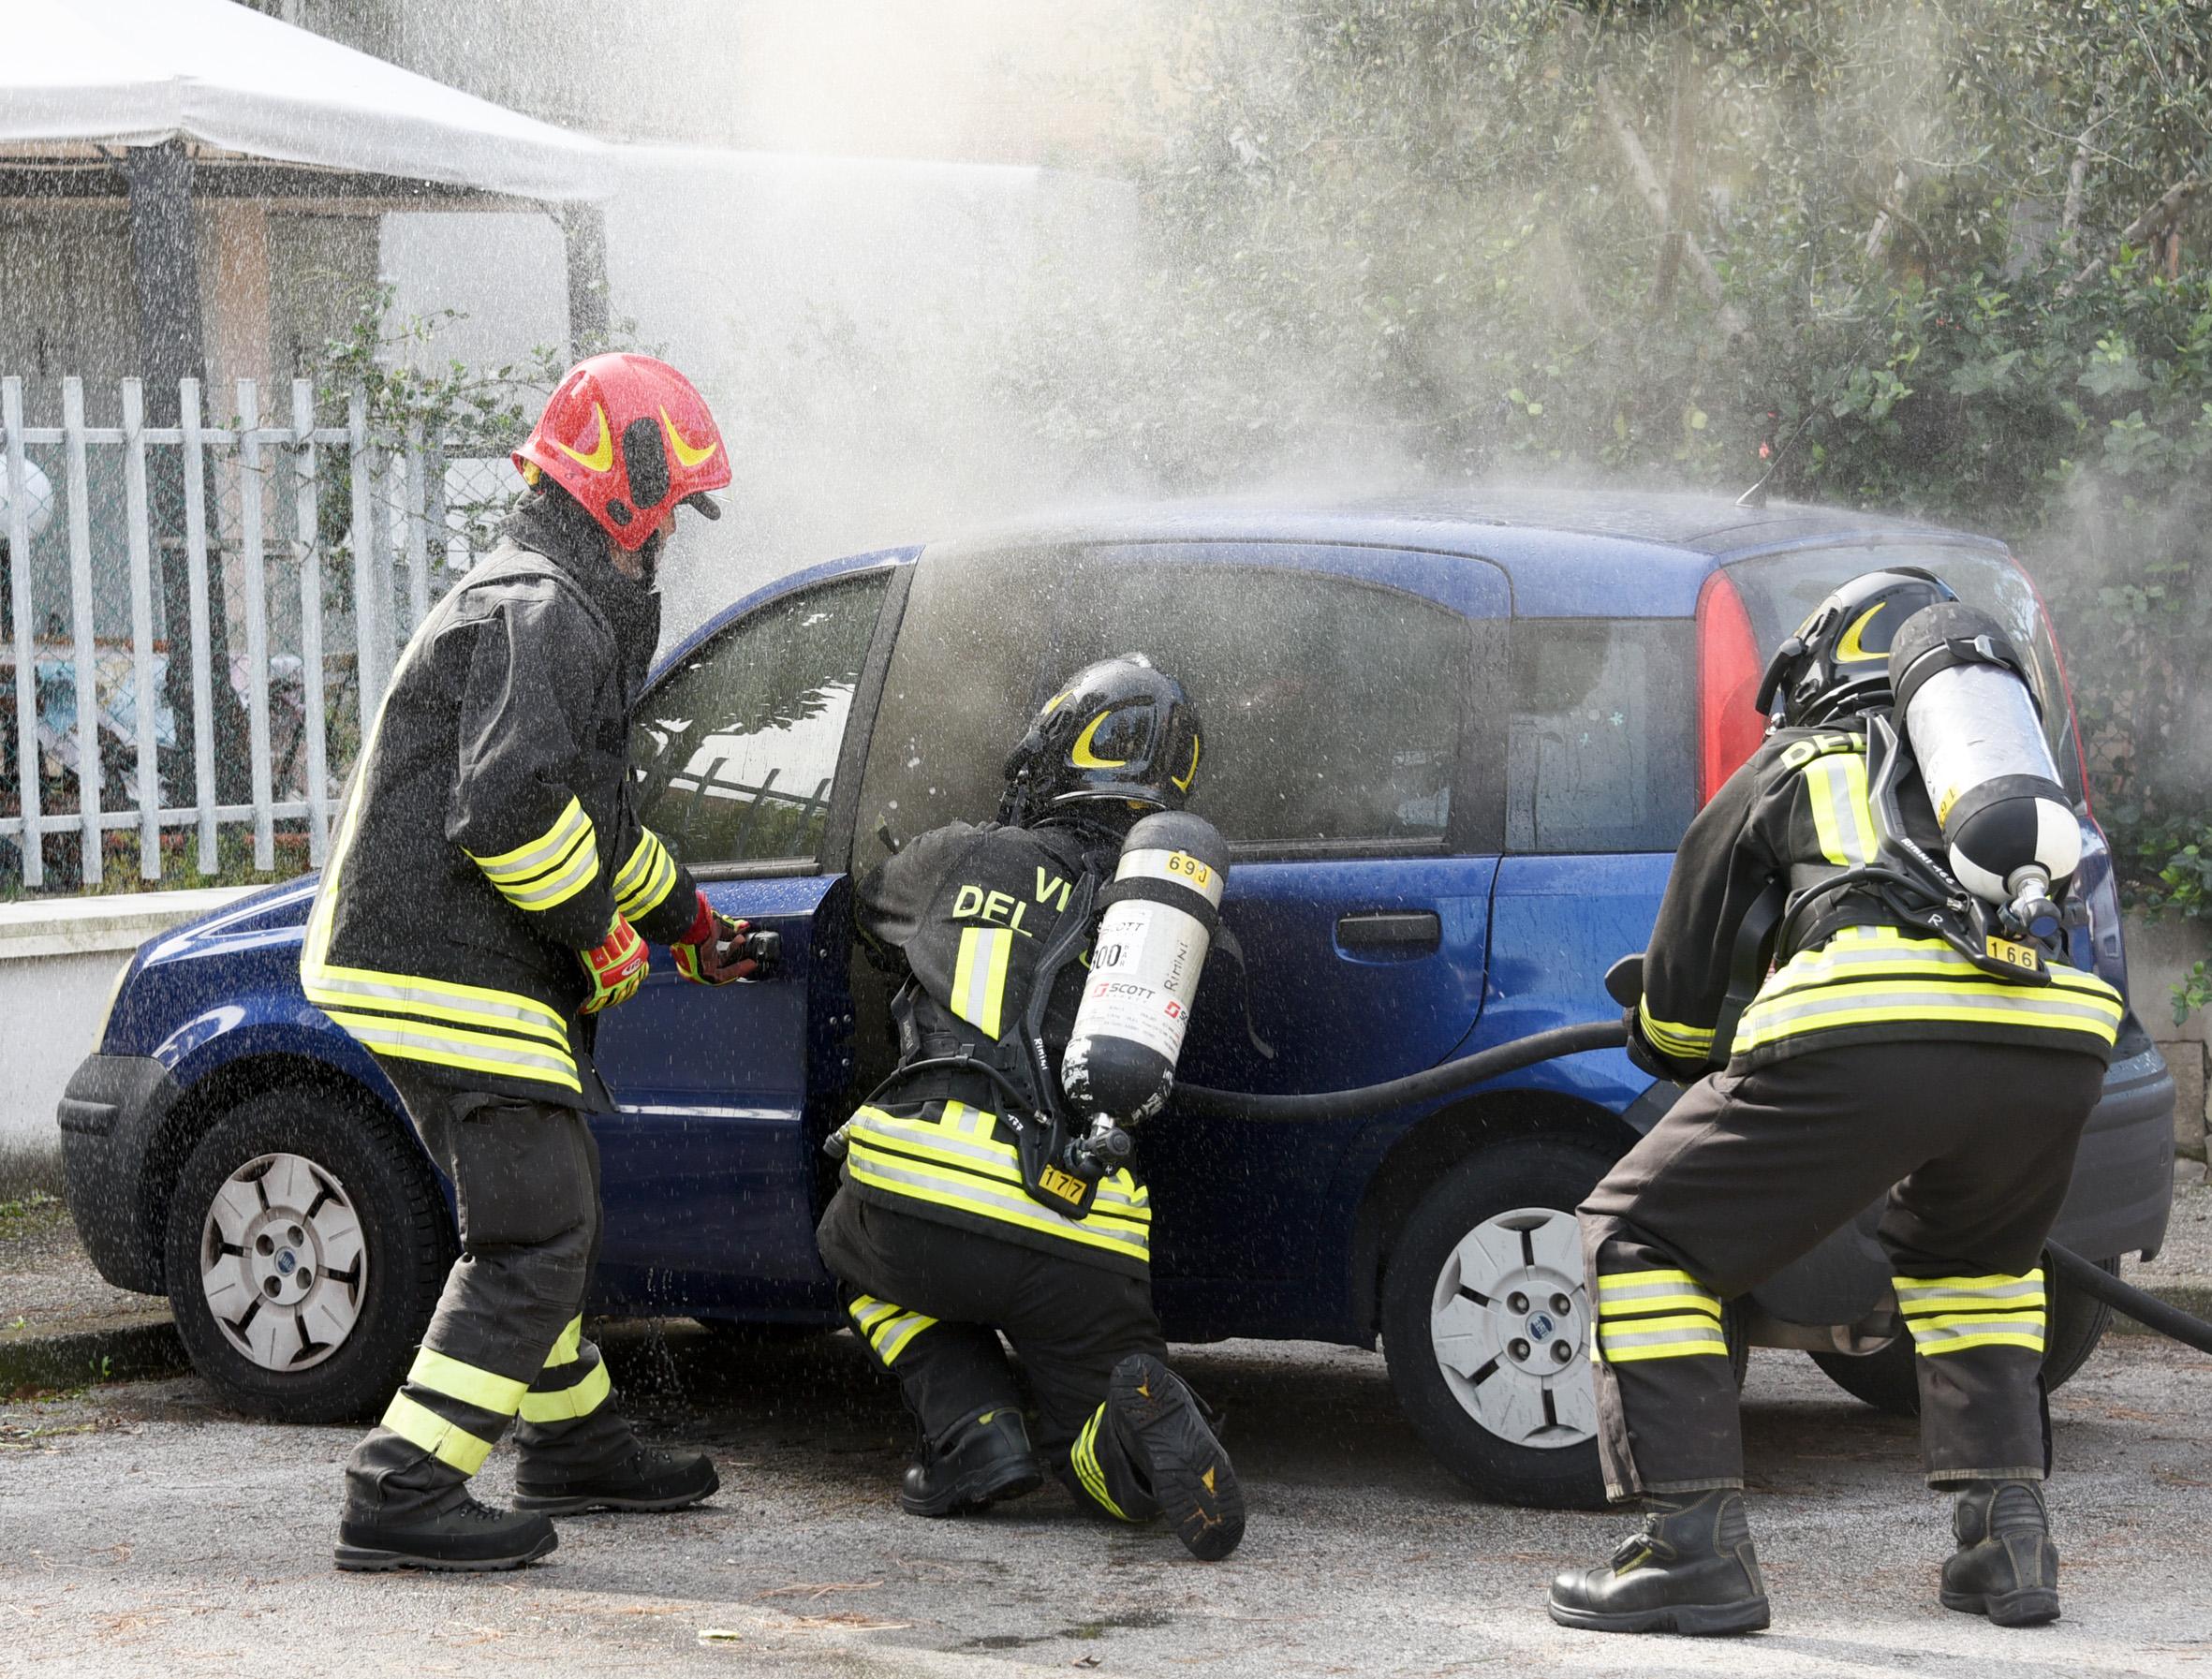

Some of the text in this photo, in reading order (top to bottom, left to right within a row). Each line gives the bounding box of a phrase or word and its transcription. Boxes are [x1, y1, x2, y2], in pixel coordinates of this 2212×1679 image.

[1990, 941, 2032, 968] 166
[1109, 982, 1156, 1000] SCOTT
[1045, 1171, 1083, 1199] 177
